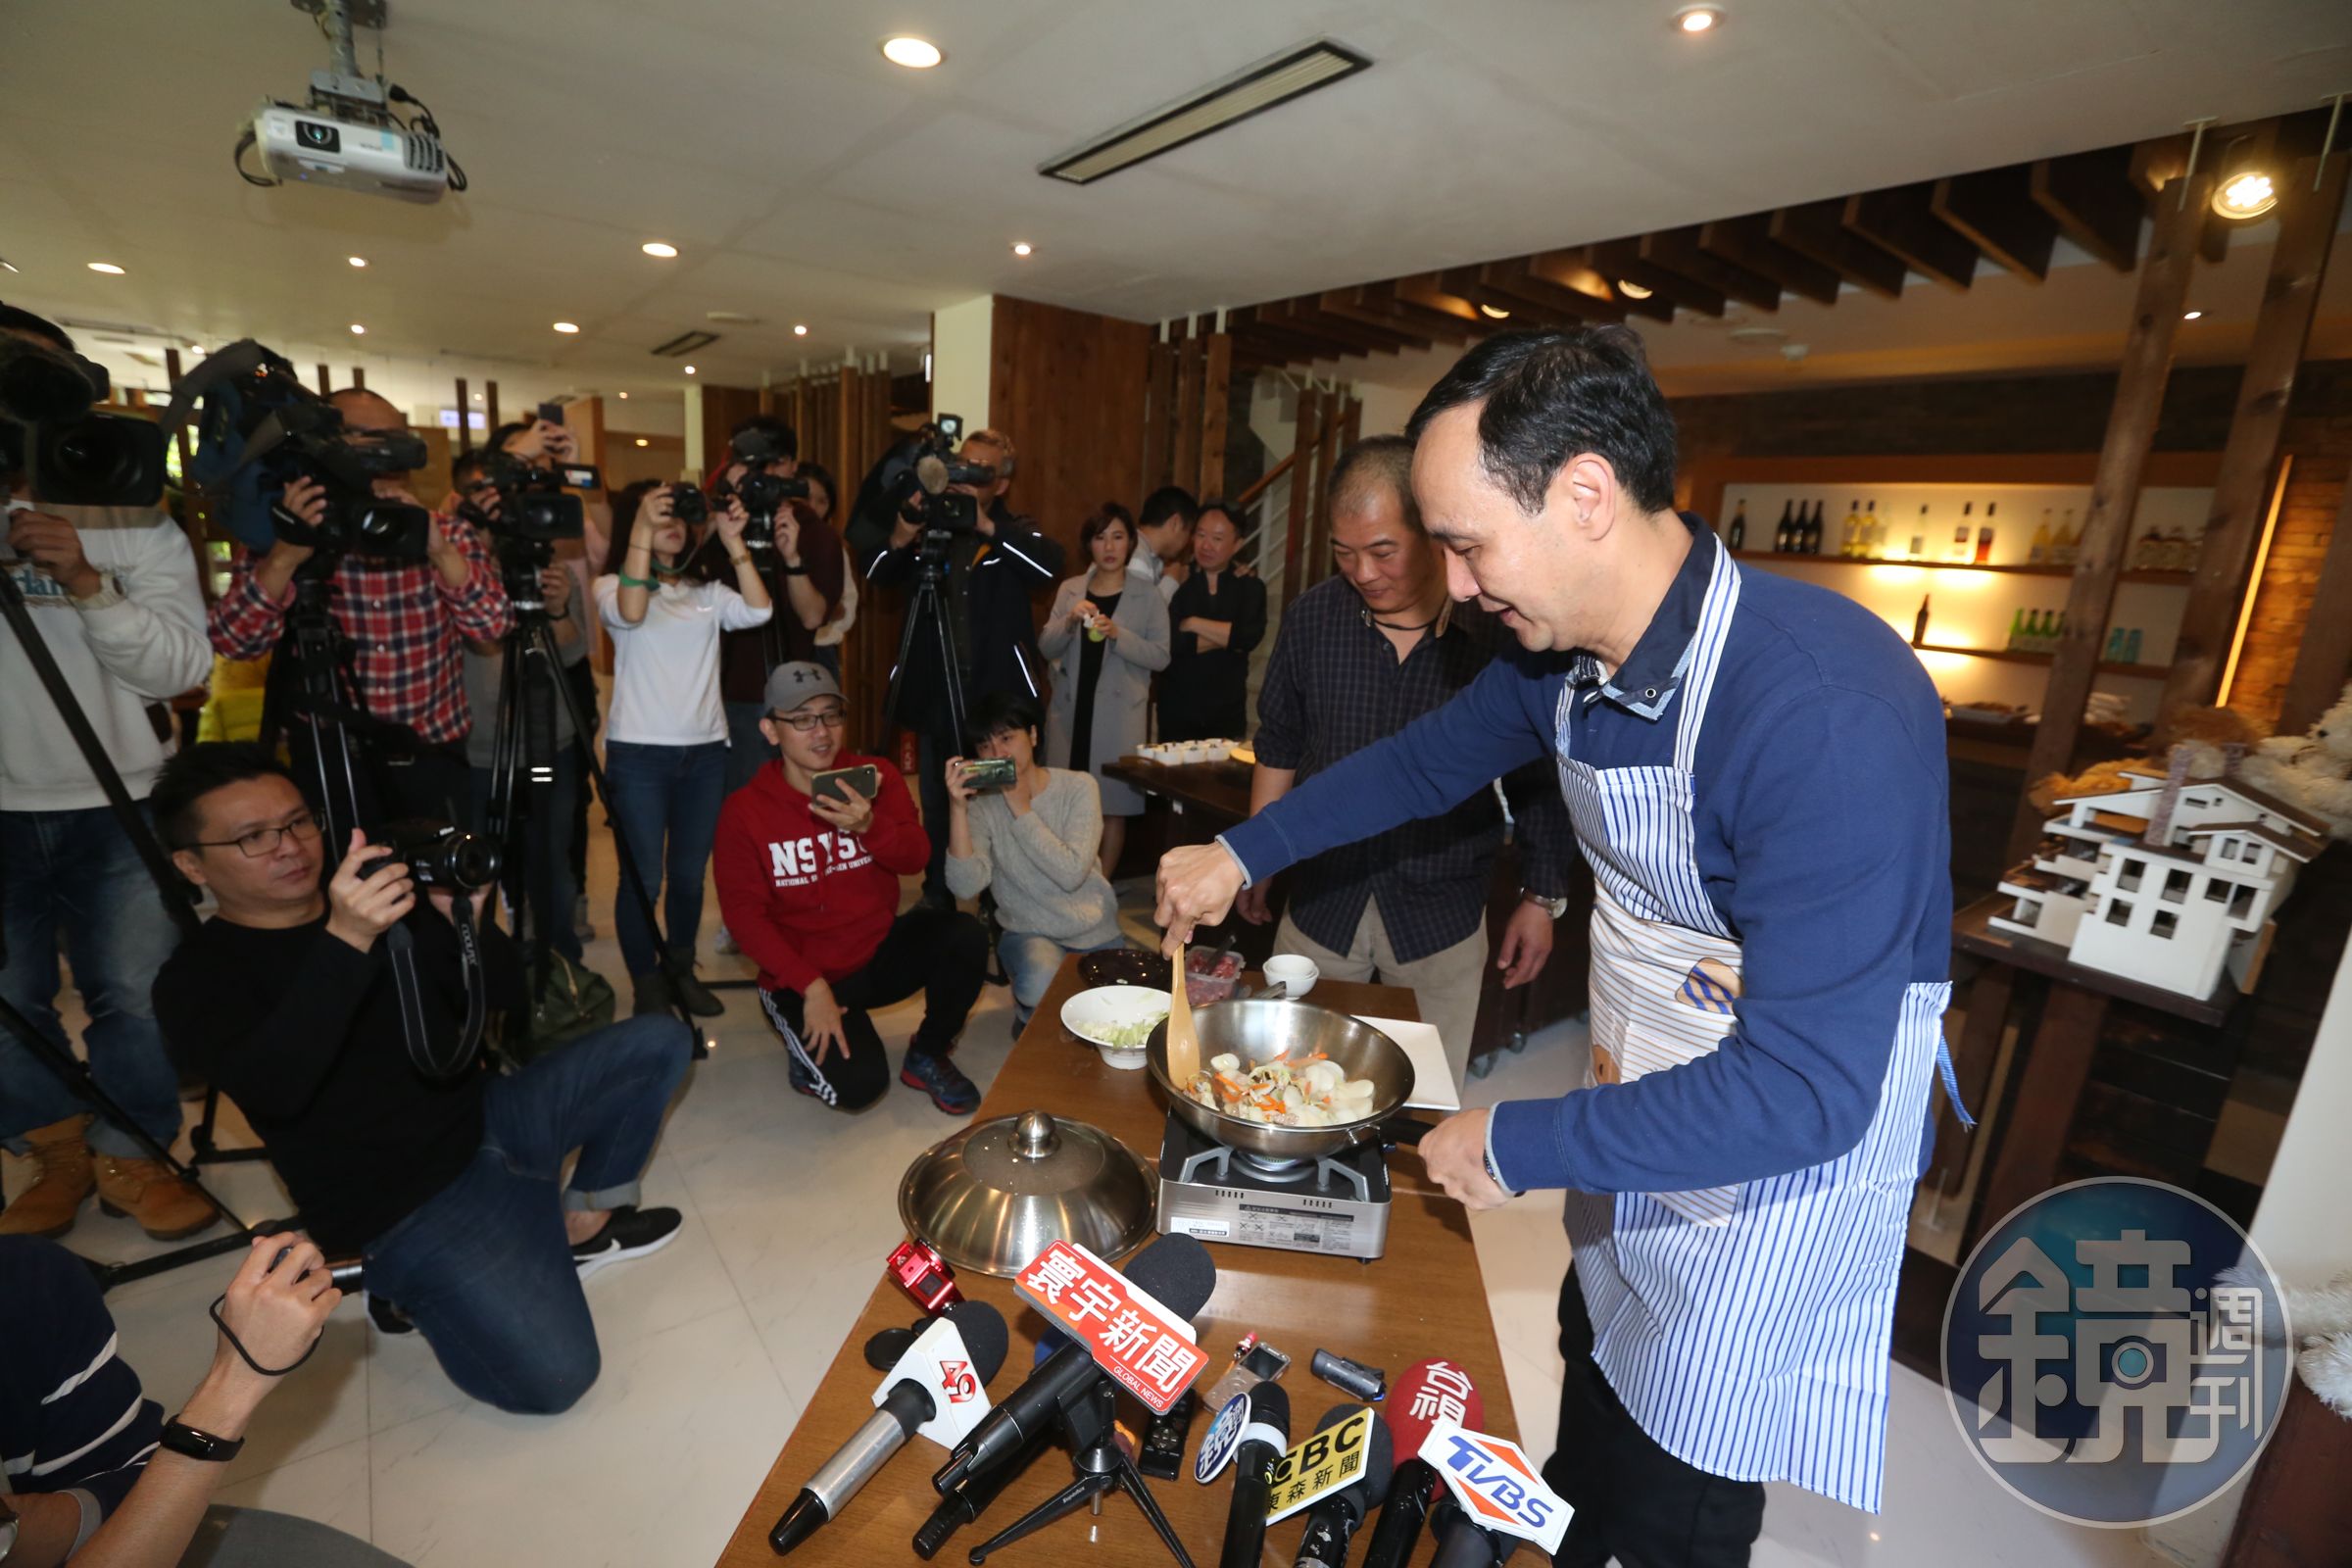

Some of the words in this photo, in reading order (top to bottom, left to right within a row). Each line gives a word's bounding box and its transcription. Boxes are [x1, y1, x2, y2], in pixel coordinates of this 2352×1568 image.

[768, 828, 868, 877] NSYS
[1027, 1250, 1199, 1393] 寰宇新聞
[1113, 1365, 1141, 1392] GLOBAL
[1140, 1387, 1164, 1409] NEWS
[1409, 1361, 1473, 1428] 台視
[1447, 1436, 1553, 1528] TVBS
